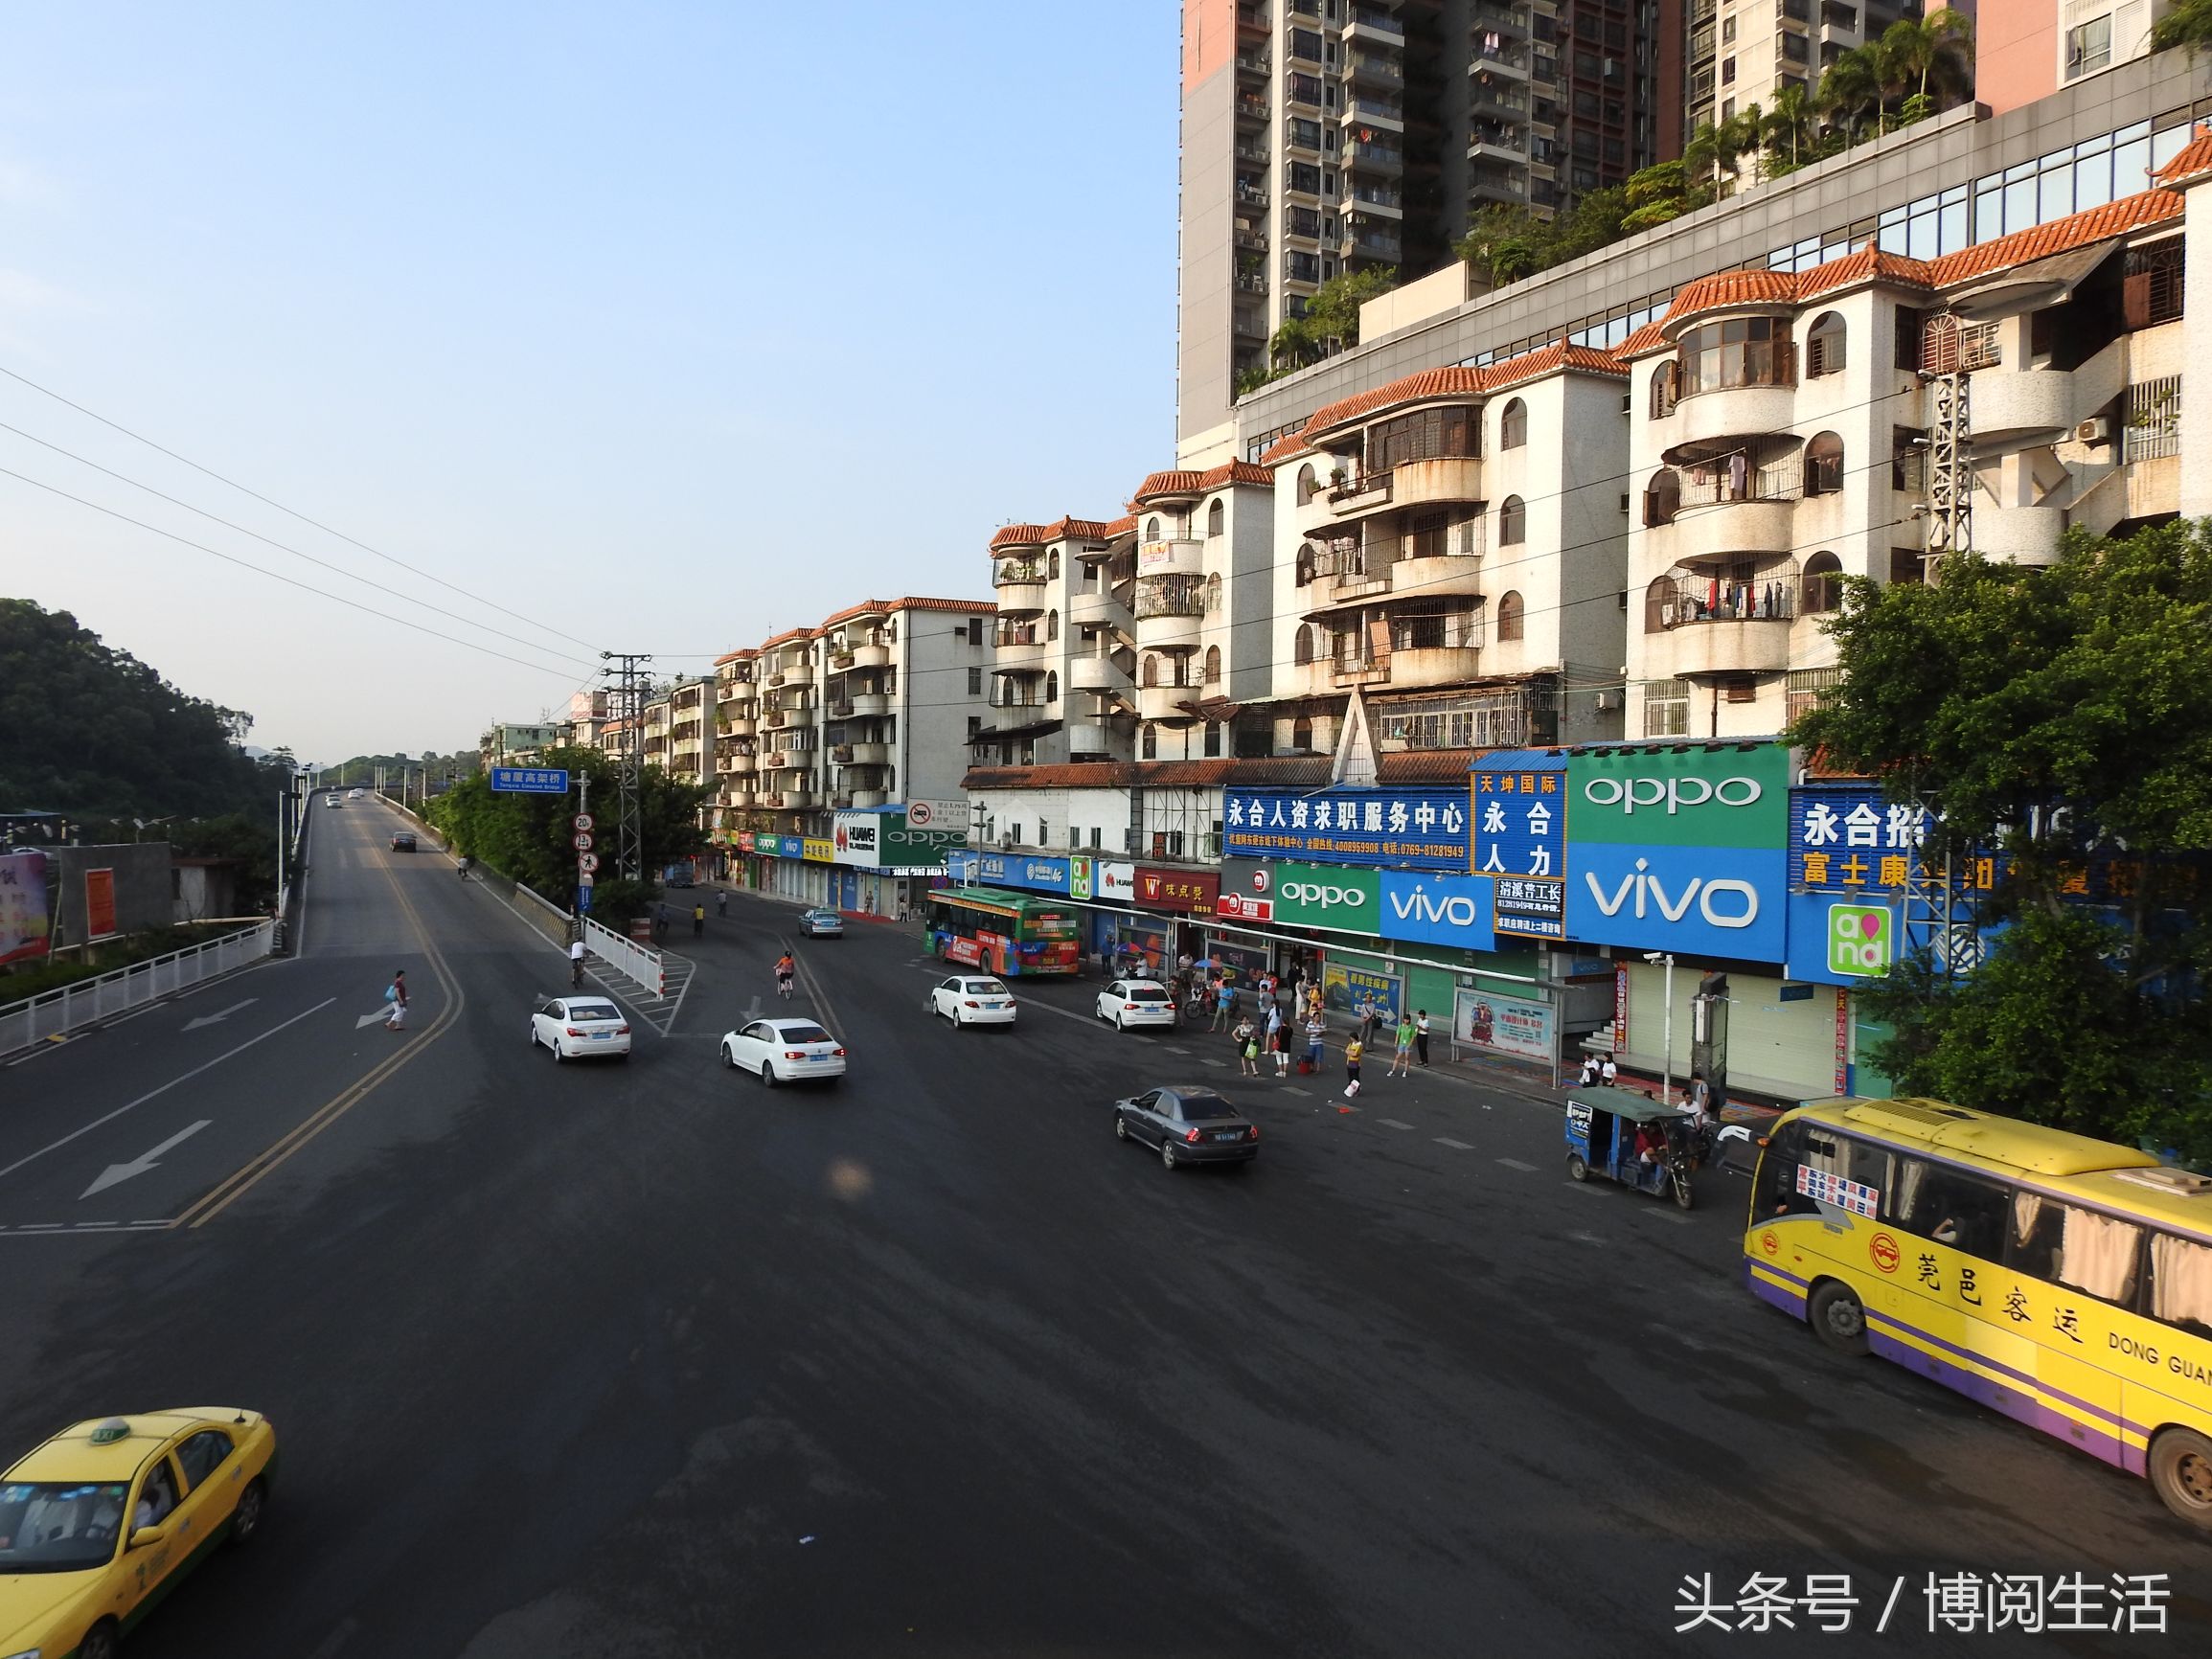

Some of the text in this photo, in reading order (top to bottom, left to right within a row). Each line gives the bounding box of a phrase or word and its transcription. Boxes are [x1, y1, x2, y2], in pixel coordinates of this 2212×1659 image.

[500, 771, 560, 784] 塘厦高架桥
[1480, 775, 1557, 794] 天坤国际
[1585, 777, 1762, 814] oppo
[1228, 798, 1464, 833] 永合人资求职服务中心
[1483, 801, 1552, 835] 永合
[887, 830, 968, 846] oppo
[1382, 841, 1464, 858] 电话:0769-81281949
[1483, 844, 1551, 876] 人力
[1282, 882, 1366, 909] oppo
[1390, 884, 1476, 926] vivo
[1585, 857, 1759, 928] vivo
[1917, 1253, 2084, 1344] 莞邑客运
[2109, 1331, 2159, 1365] DONG
